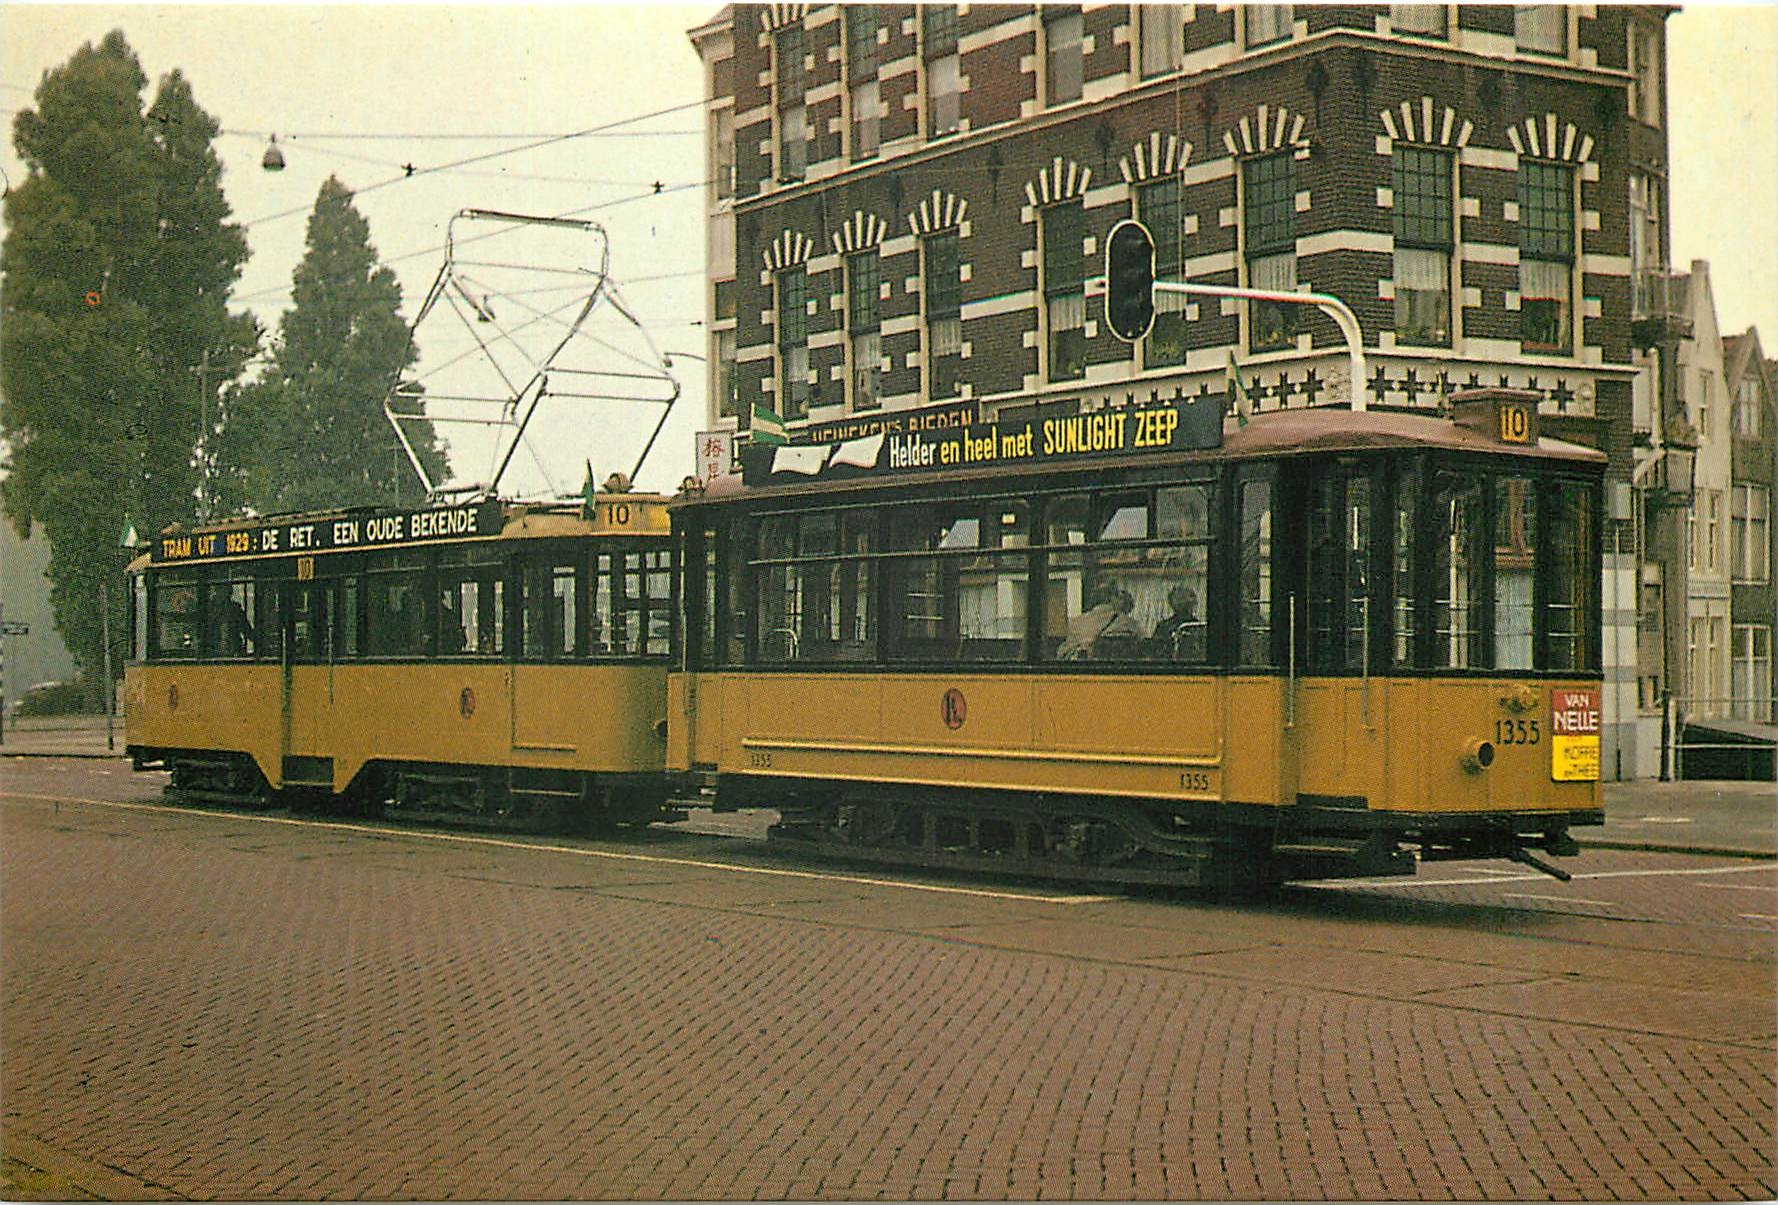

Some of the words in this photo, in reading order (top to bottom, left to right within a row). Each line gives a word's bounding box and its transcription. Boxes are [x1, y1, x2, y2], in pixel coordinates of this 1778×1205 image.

[1505, 408, 1525, 437] 10
[890, 434, 936, 468] Helder
[940, 440, 960, 464] en
[964, 425, 997, 462] heel
[1002, 424, 1033, 458] met
[1043, 413, 1127, 455] SUNLIGHT
[1134, 409, 1178, 447] ZEEP
[609, 504, 629, 524] 10
[162, 538, 191, 558] TRAM
[198, 535, 217, 556] UIT
[262, 529, 279, 550] DE
[290, 526, 320, 547] RET.
[333, 521, 359, 545] EEN
[366, 516, 404, 541] OUDE
[411, 508, 478, 537] BEKENDE
[1564, 694, 1590, 707] VAN
[1553, 711, 1599, 731] NELLE
[1496, 720, 1540, 744] 1355
[752, 752, 771, 768] 1355
[1180, 773, 1208, 790] 1355
